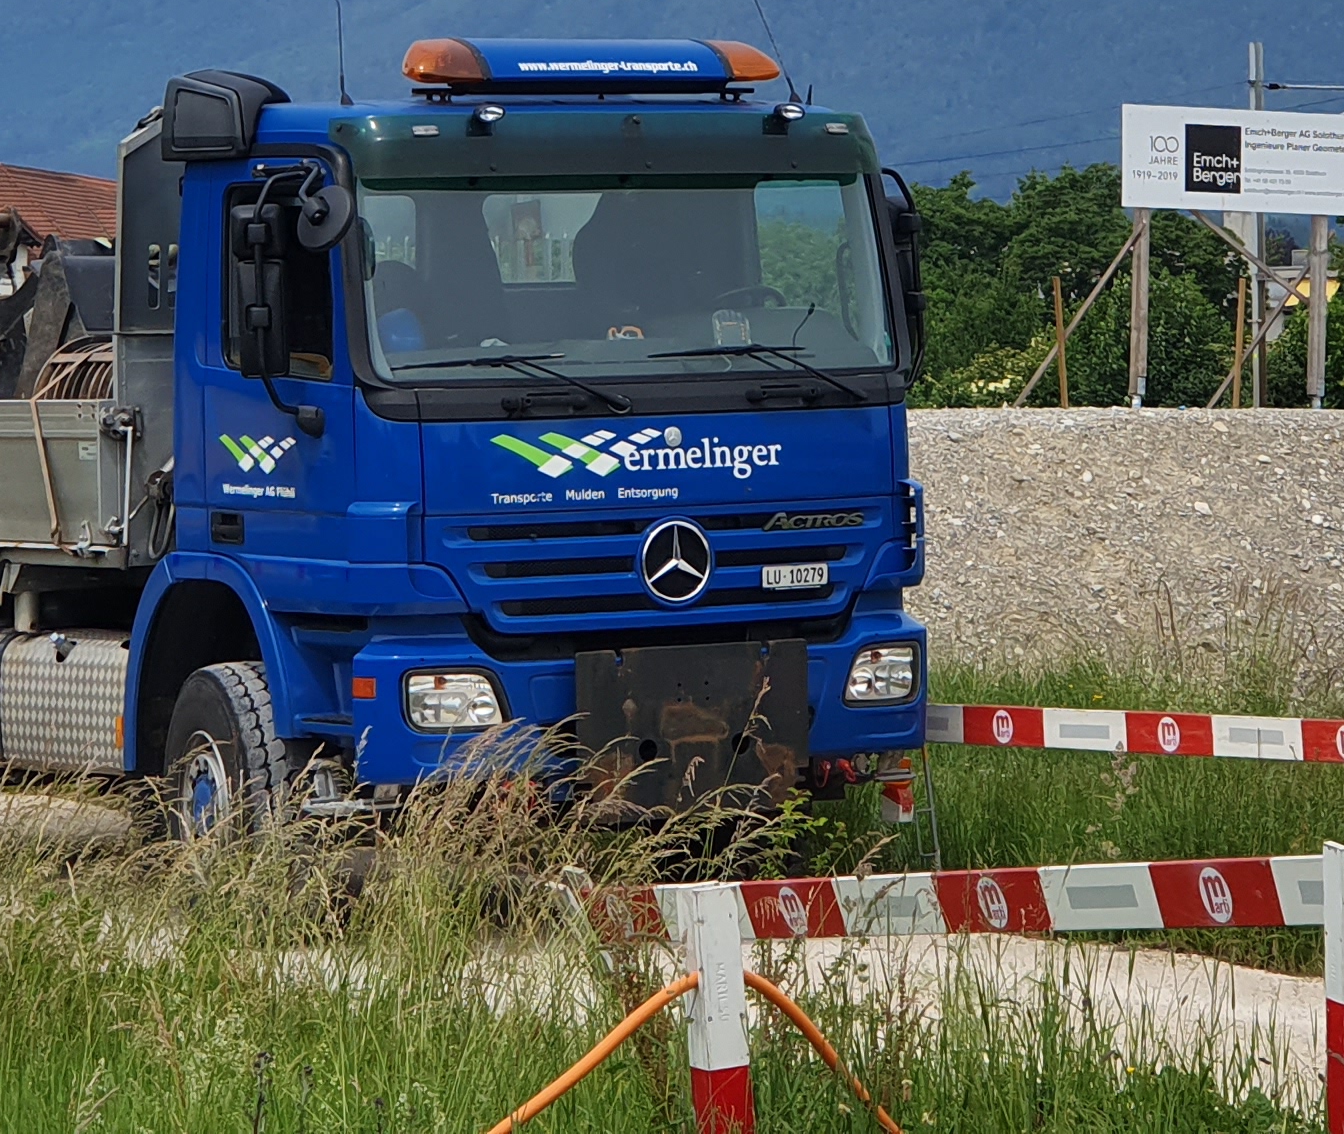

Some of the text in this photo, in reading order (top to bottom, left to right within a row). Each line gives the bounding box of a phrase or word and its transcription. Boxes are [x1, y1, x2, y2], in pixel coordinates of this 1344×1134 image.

[1298, 130, 1311, 139] AG
[1149, 135, 1180, 153] 100
[1149, 156, 1179, 166] JAHRE
[1193, 152, 1240, 168] Emch+
[565, 488, 605, 502] Mulden
[617, 487, 679, 501] Entsorgung
[1202, 874, 1230, 915] marti
